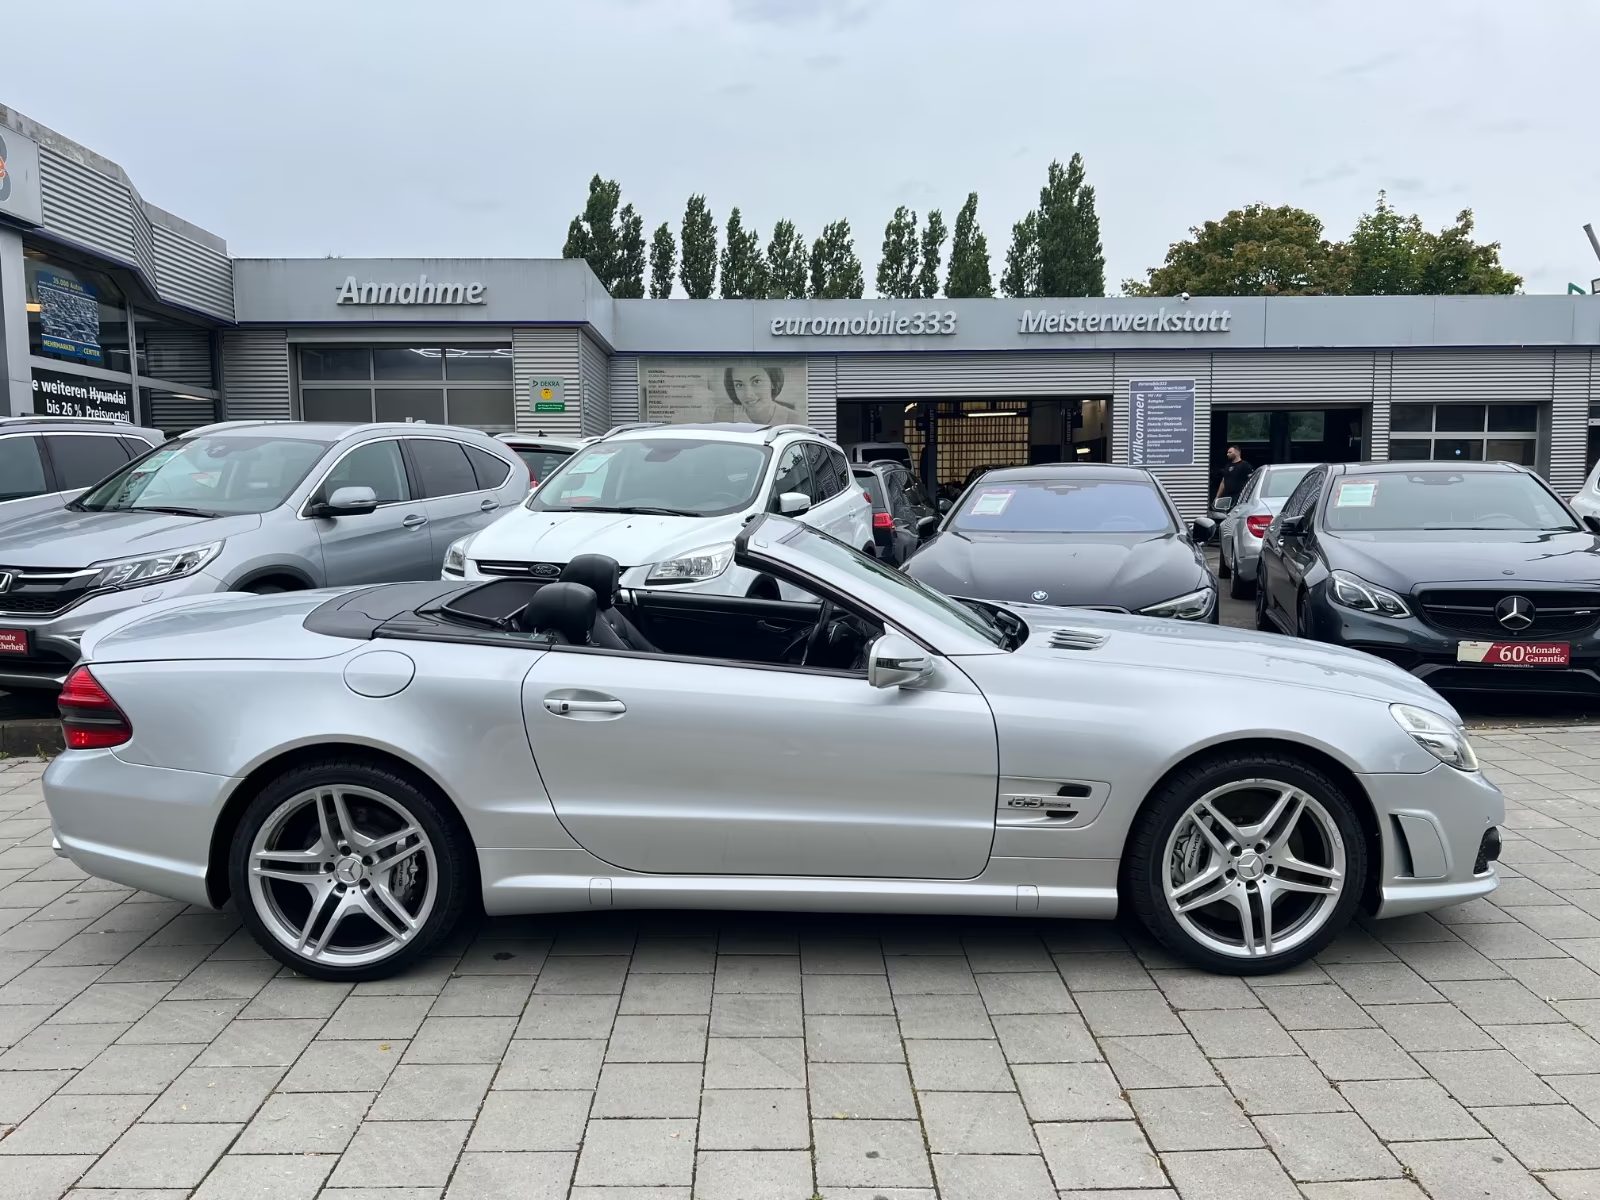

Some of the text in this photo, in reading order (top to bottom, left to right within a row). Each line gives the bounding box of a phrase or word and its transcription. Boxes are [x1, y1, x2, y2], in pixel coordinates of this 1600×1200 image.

[336, 274, 484, 305] Annahme
[770, 310, 957, 335] euromobile333
[1020, 307, 1231, 333] Meisterwerkstatt
[41, 380, 87, 399] weiteren
[89, 386, 126, 405] Hyundai
[46, 398, 130, 422] bis 26 % Preisvorteil
[1500, 645, 1561, 662] 60 Monate
